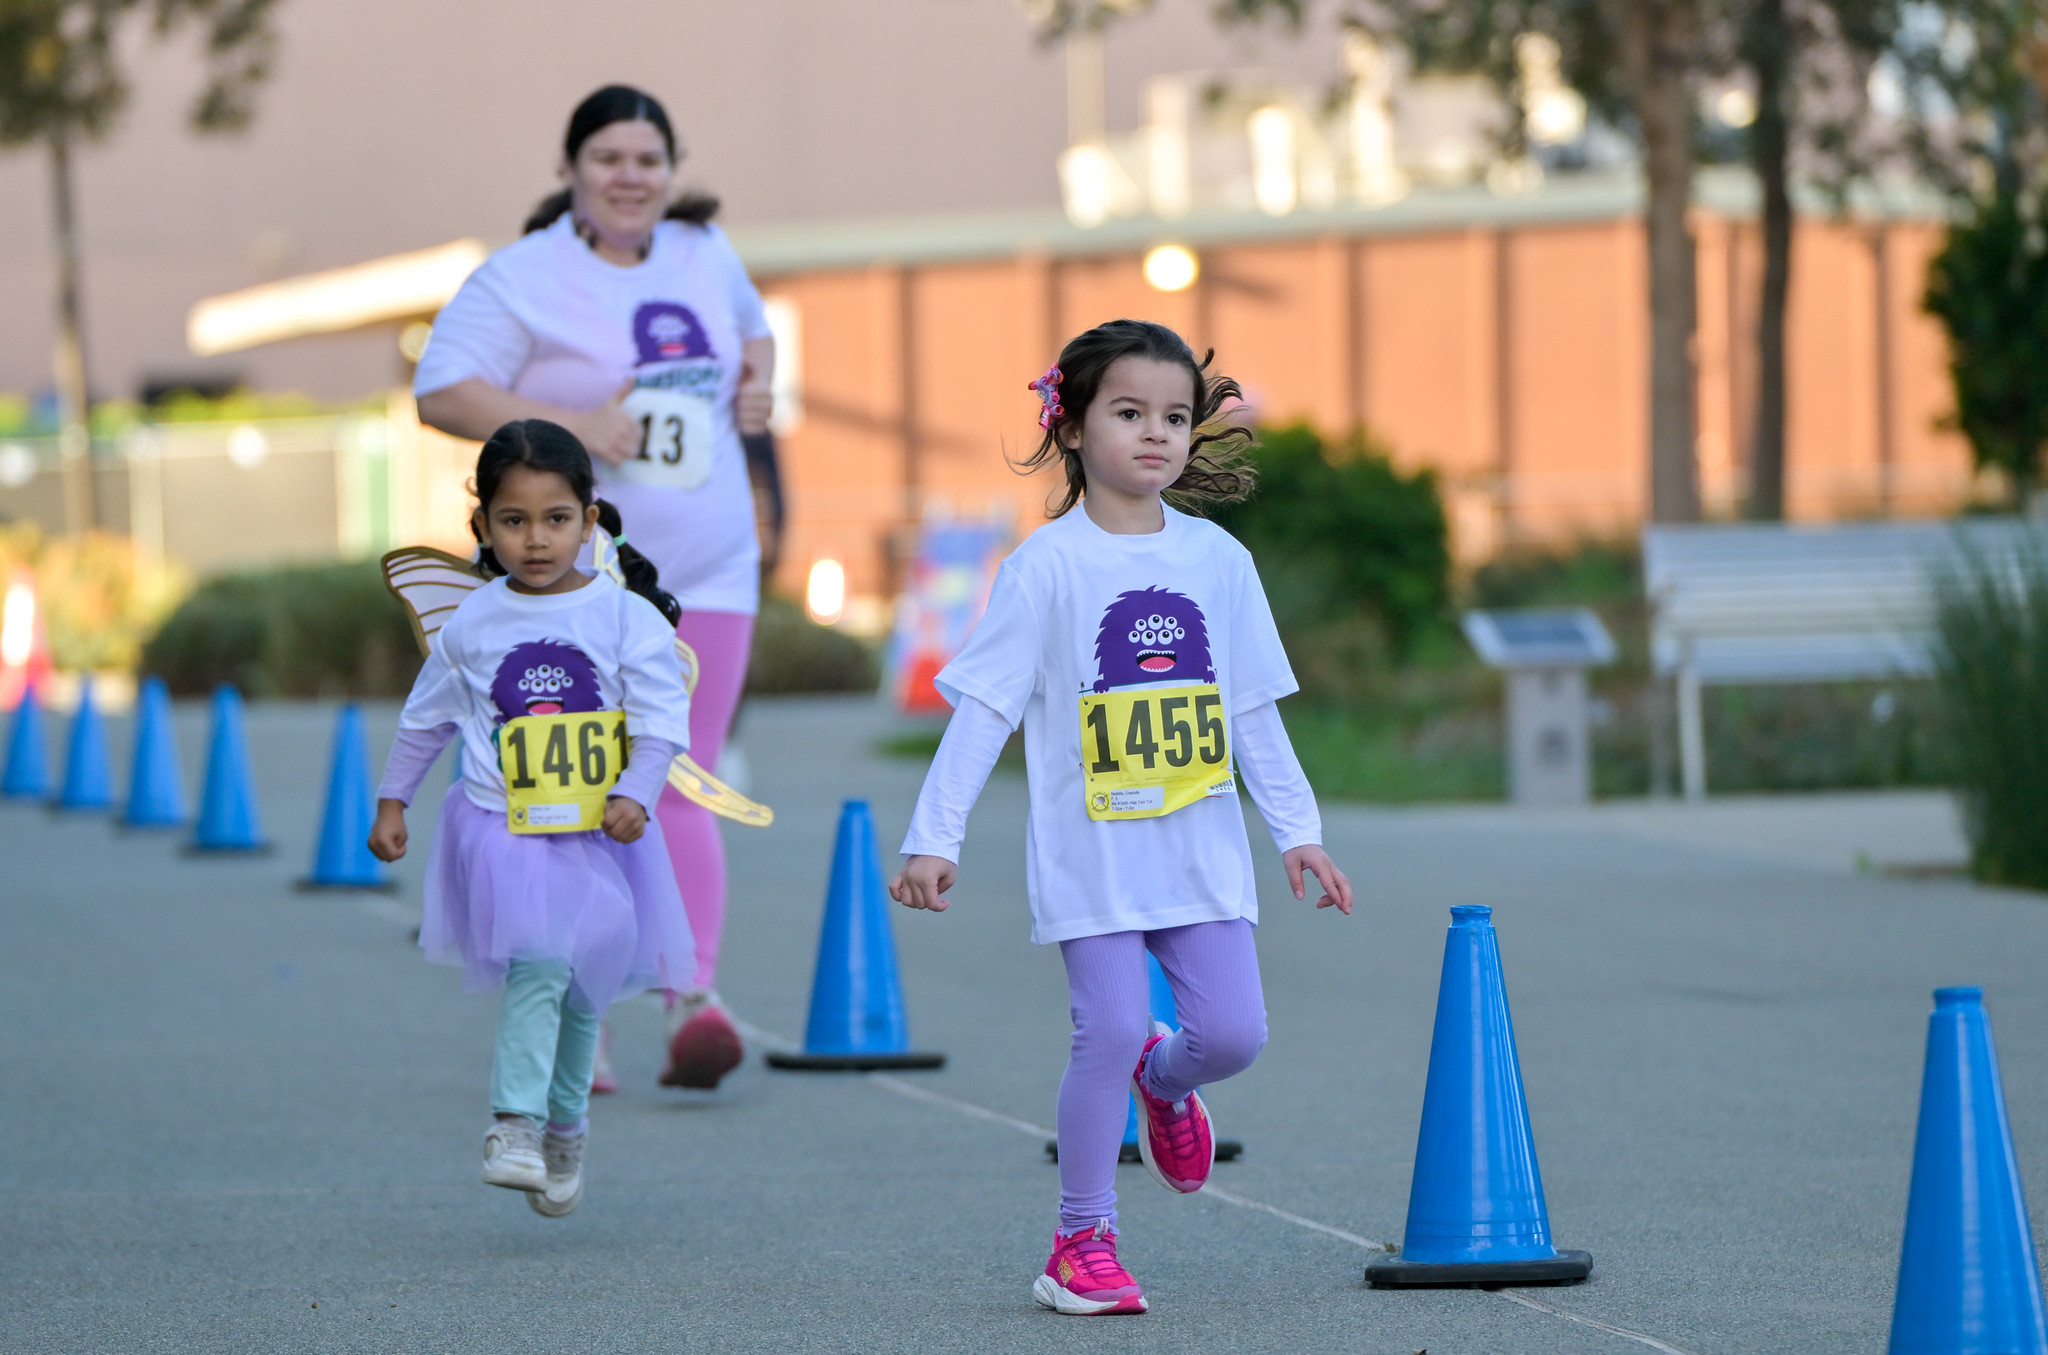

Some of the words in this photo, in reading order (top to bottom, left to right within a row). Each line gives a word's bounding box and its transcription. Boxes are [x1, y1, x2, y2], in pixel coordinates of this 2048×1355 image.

[636, 413, 684, 465] 13
[507, 719, 629, 789] 1461
[1086, 693, 1226, 774] 1455
